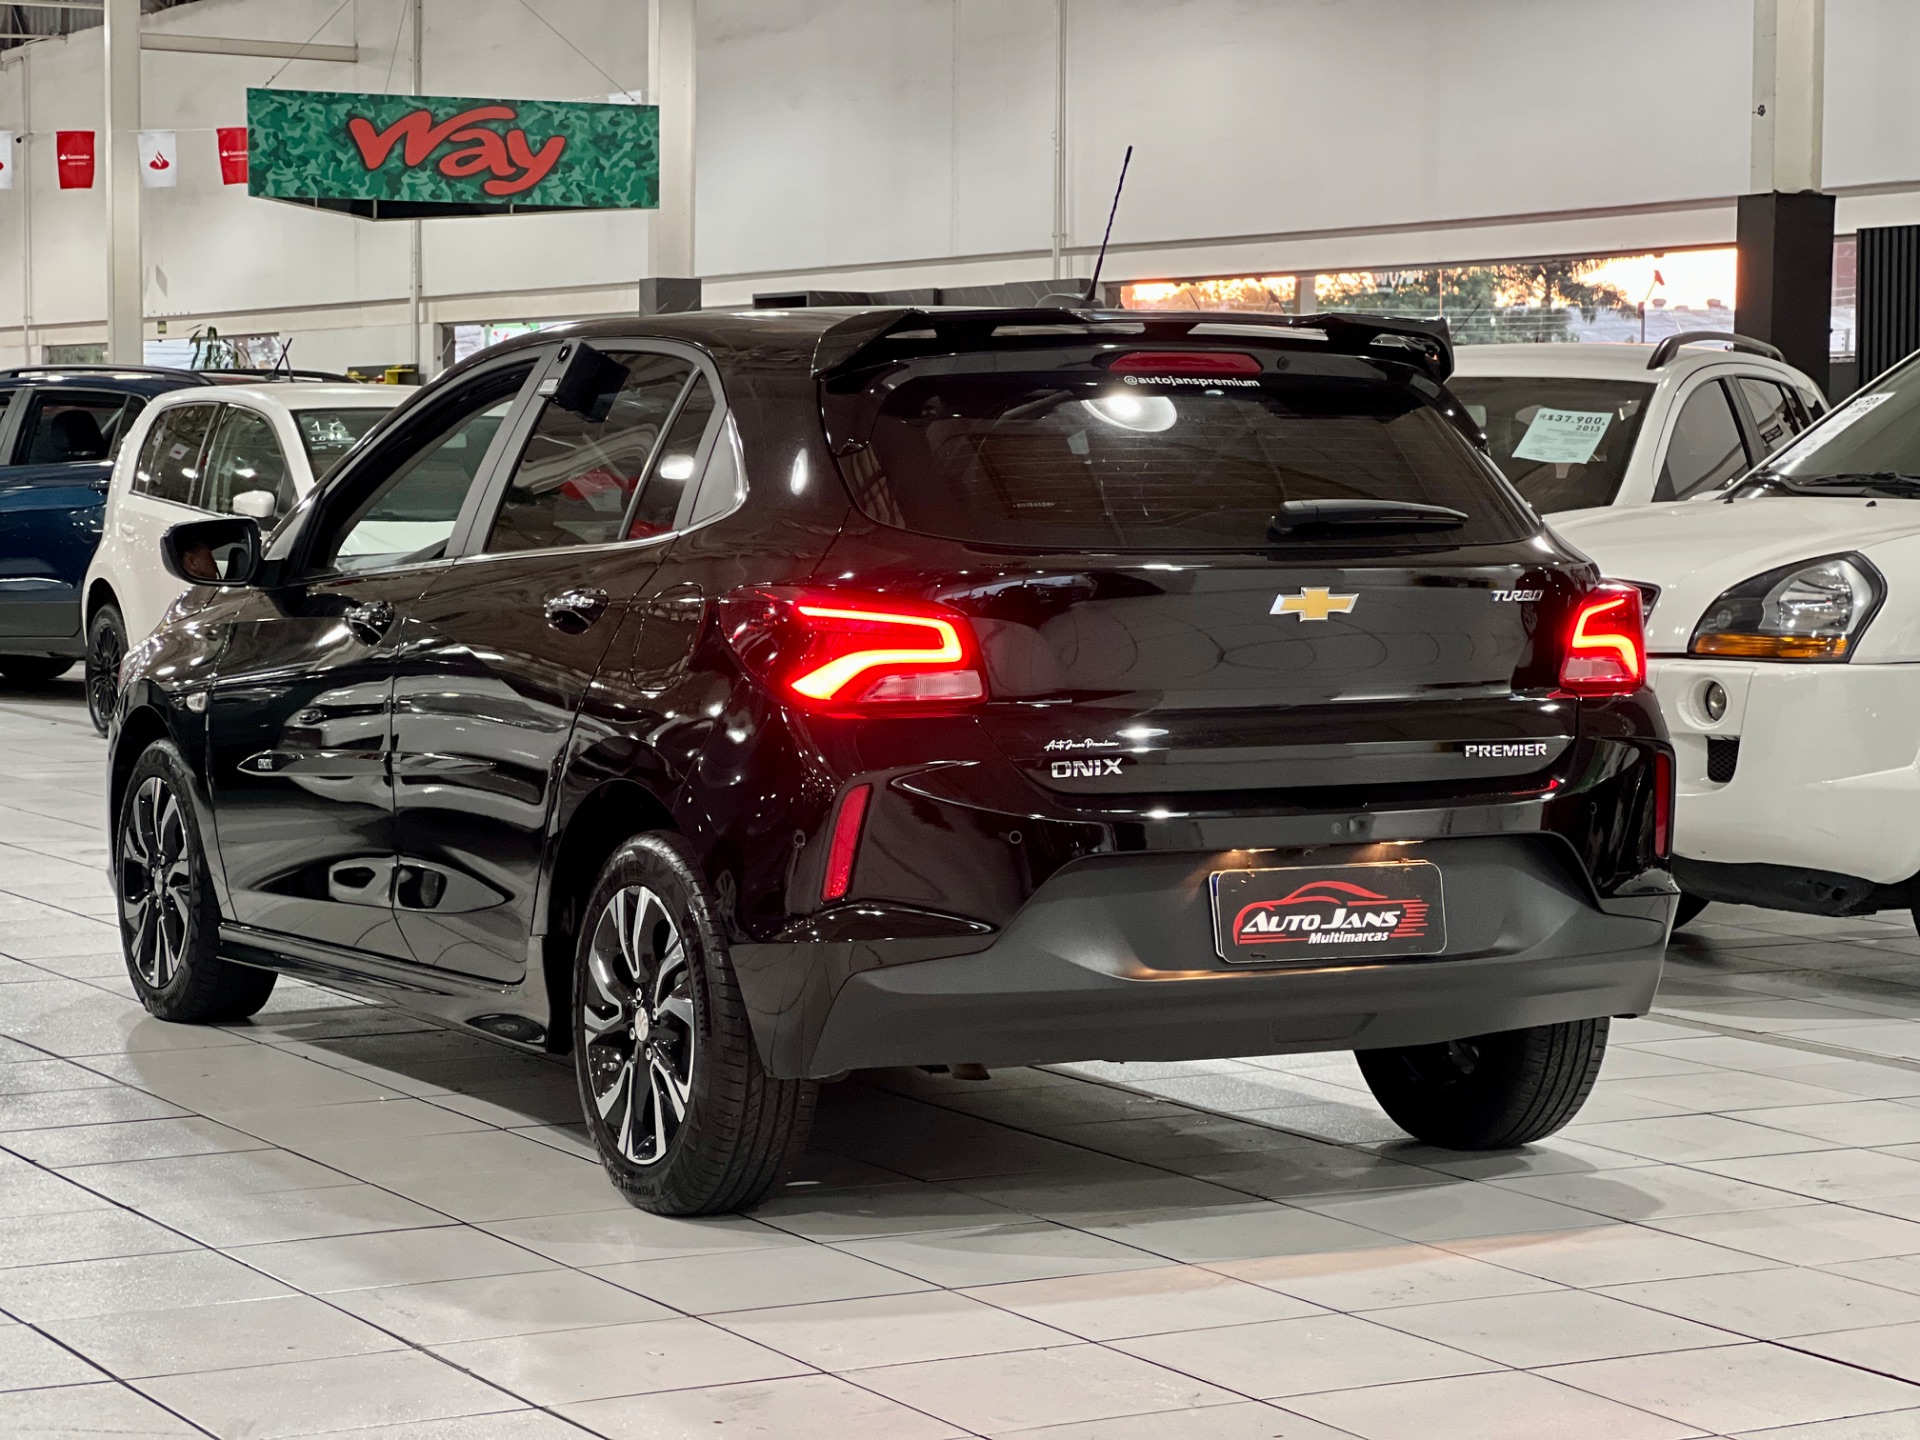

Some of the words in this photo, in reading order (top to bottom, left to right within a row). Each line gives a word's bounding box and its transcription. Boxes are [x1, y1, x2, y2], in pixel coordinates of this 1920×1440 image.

[349, 106, 567, 196] Way
[1123, 375, 1261, 388] @autojanspremium
[1490, 589, 1545, 602] TURBO
[1465, 743, 1547, 758] PREMIER
[1051, 757, 1123, 778] ONIX
[1307, 931, 1389, 945] Multimarcas
